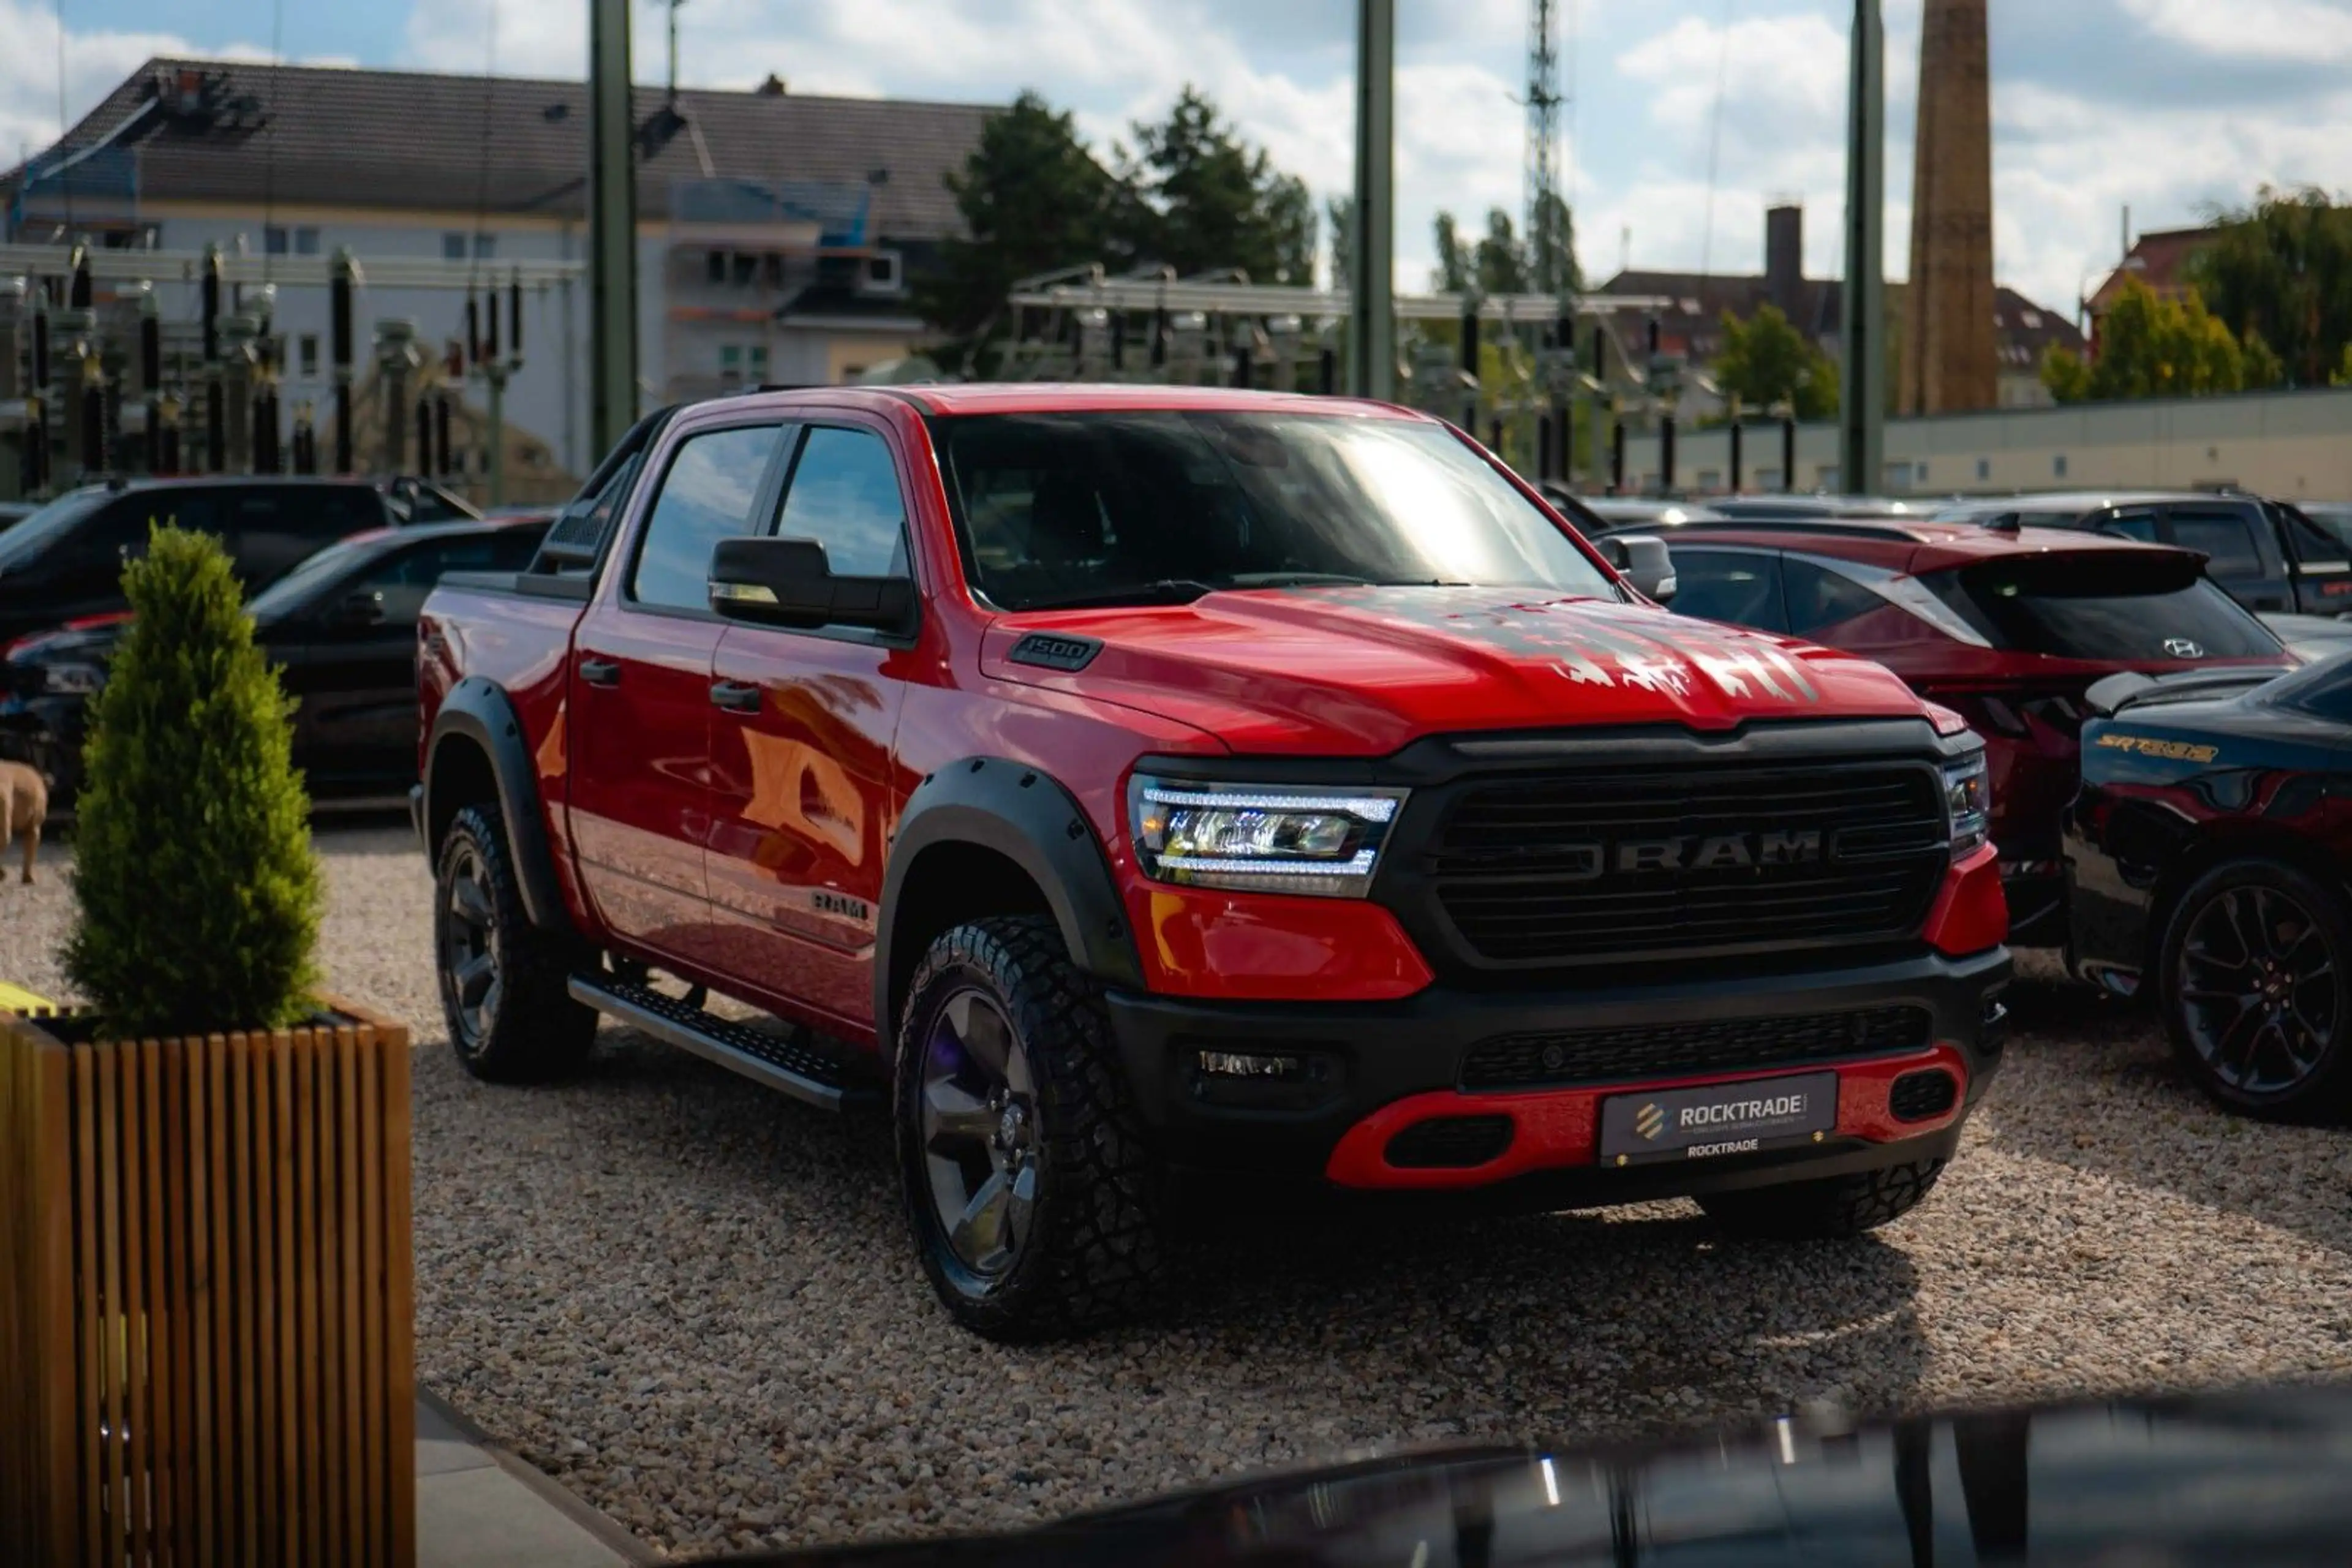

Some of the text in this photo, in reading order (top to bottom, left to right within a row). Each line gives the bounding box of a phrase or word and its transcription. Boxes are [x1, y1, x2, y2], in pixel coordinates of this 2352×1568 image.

[1028, 638, 1085, 657] 1500
[1618, 831, 1820, 871] RAM
[812, 892, 866, 919] RAM
[1680, 1095, 1801, 1127] ROCKTRADE
[1687, 1139, 1758, 1158] ROCKTRADE
